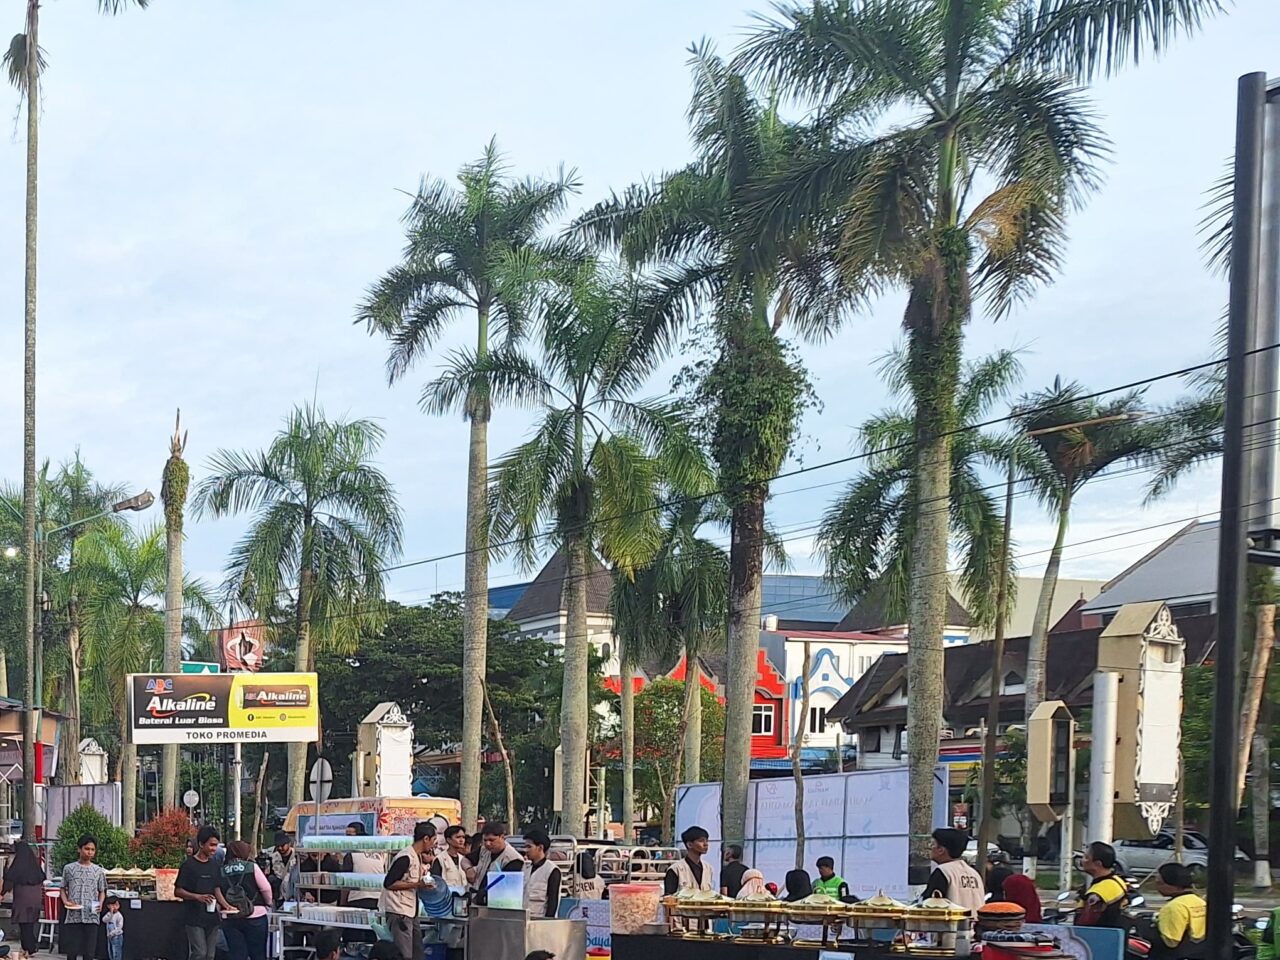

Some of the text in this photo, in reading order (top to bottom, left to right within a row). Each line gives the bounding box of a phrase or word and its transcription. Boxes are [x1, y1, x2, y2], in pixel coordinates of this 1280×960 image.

[146, 679, 173, 690] ABC
[257, 691, 307, 701] Alkaline
[146, 696, 216, 712] Alkaline
[186, 731, 268, 740] TOKO PROMEDIA
[575, 881, 595, 893] CREW
